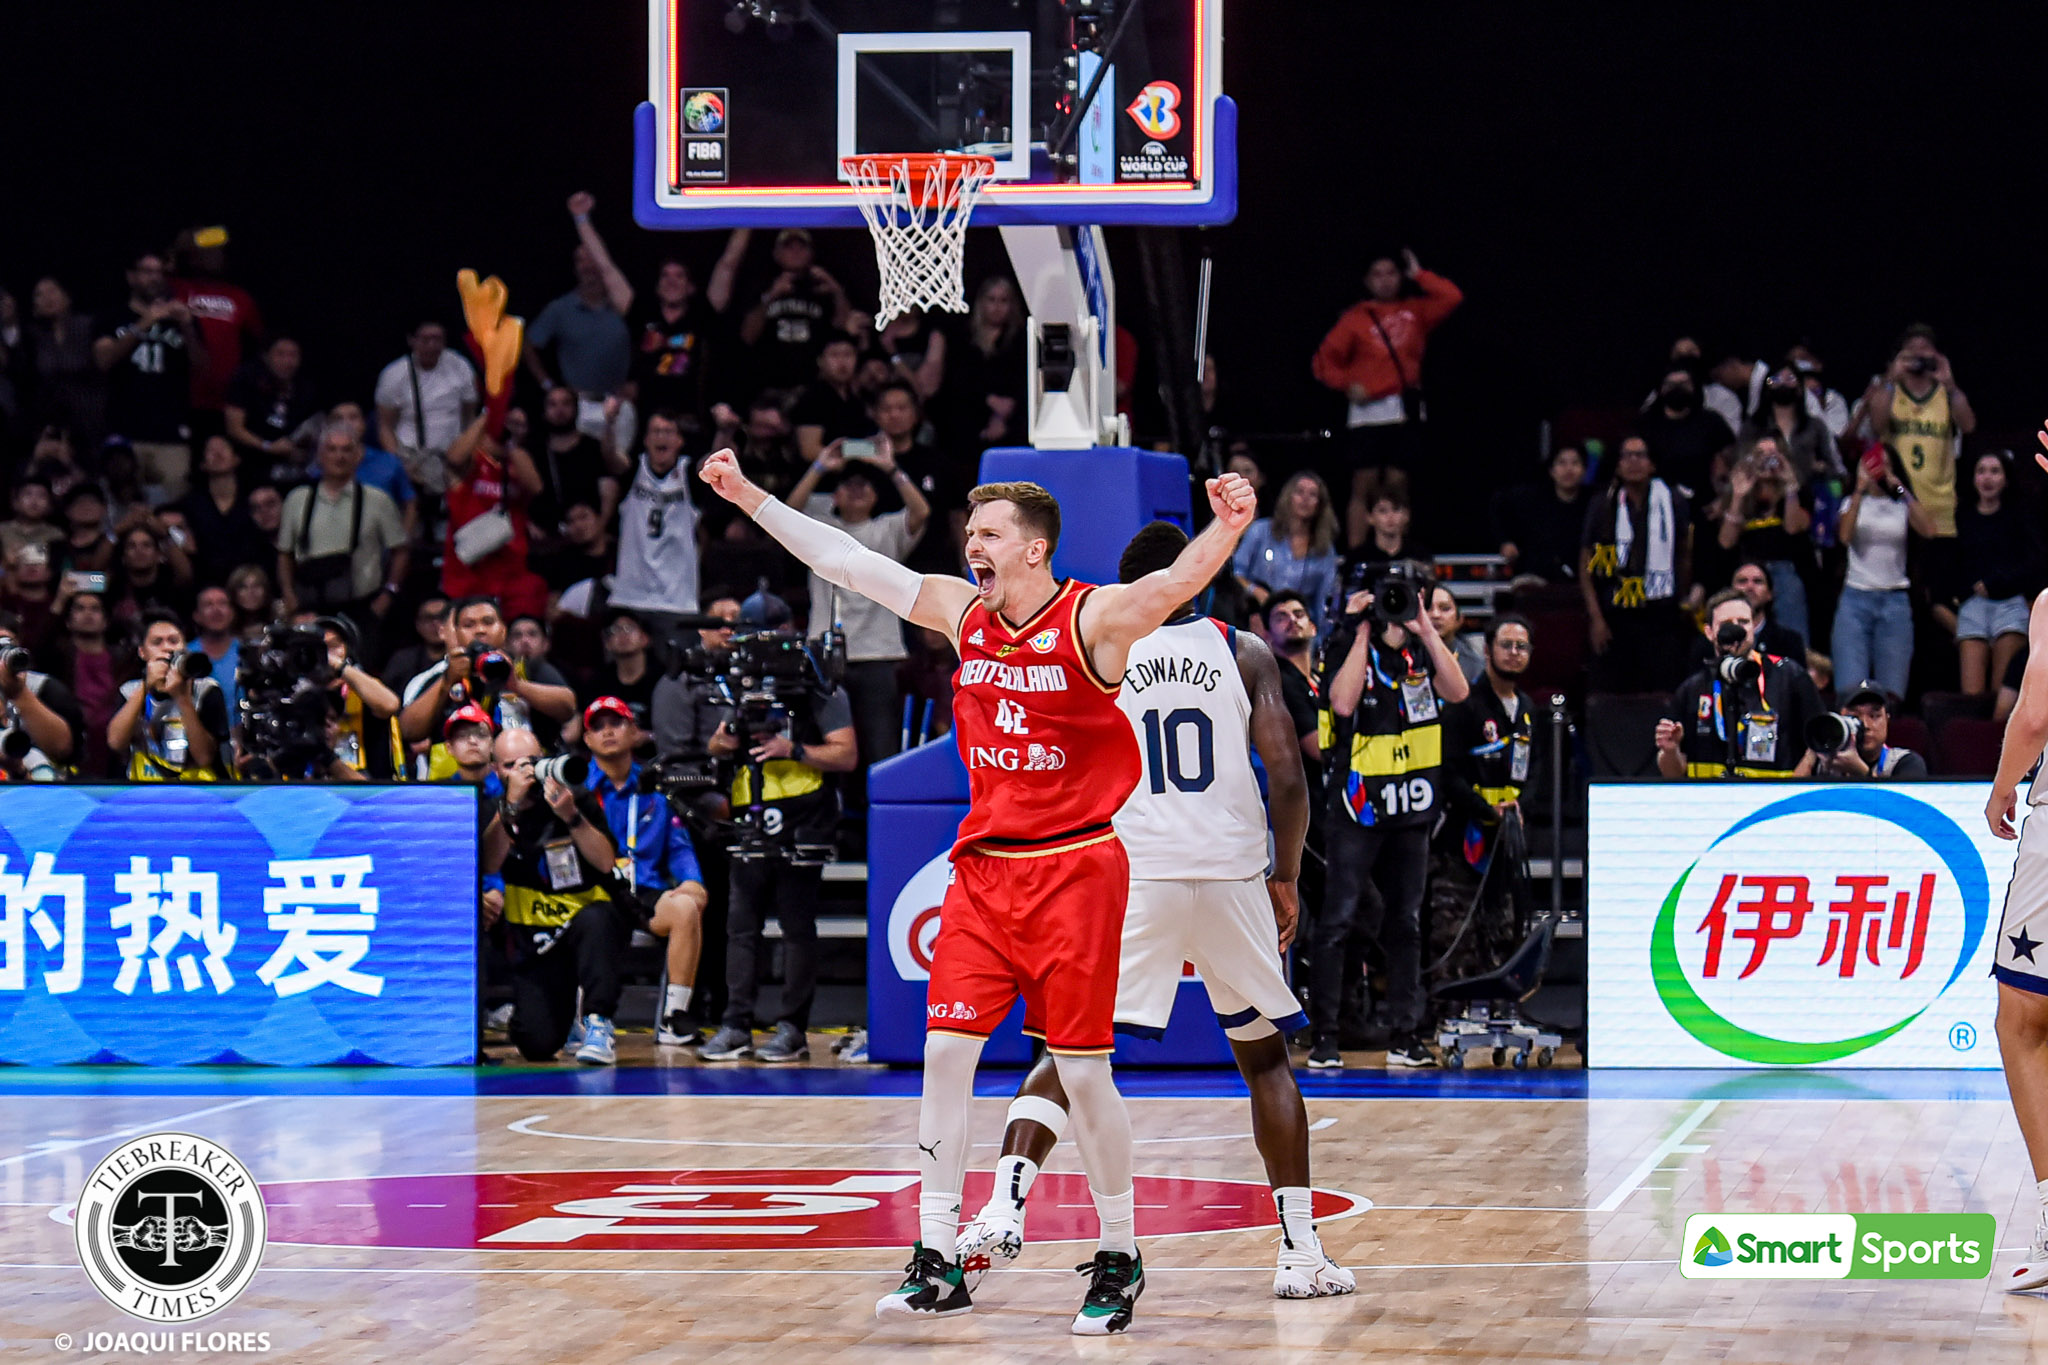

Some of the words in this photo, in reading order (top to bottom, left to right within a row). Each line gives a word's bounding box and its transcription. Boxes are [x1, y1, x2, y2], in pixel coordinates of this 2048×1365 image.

[688, 142, 722, 160] FIBA
[1120, 161, 1163, 173] WORLD
[1163, 161, 1188, 173] CUP
[647, 508, 663, 538] 9
[1123, 657, 1222, 694] EDWARDS
[994, 698, 1029, 735] 42
[969, 747, 1019, 771] ING
[1141, 707, 1215, 795] 10
[1380, 777, 1434, 816] 119
[0, 851, 386, 998] 的热爱
[1696, 873, 1937, 980] 伊利
[927, 1003, 948, 1019] NG
